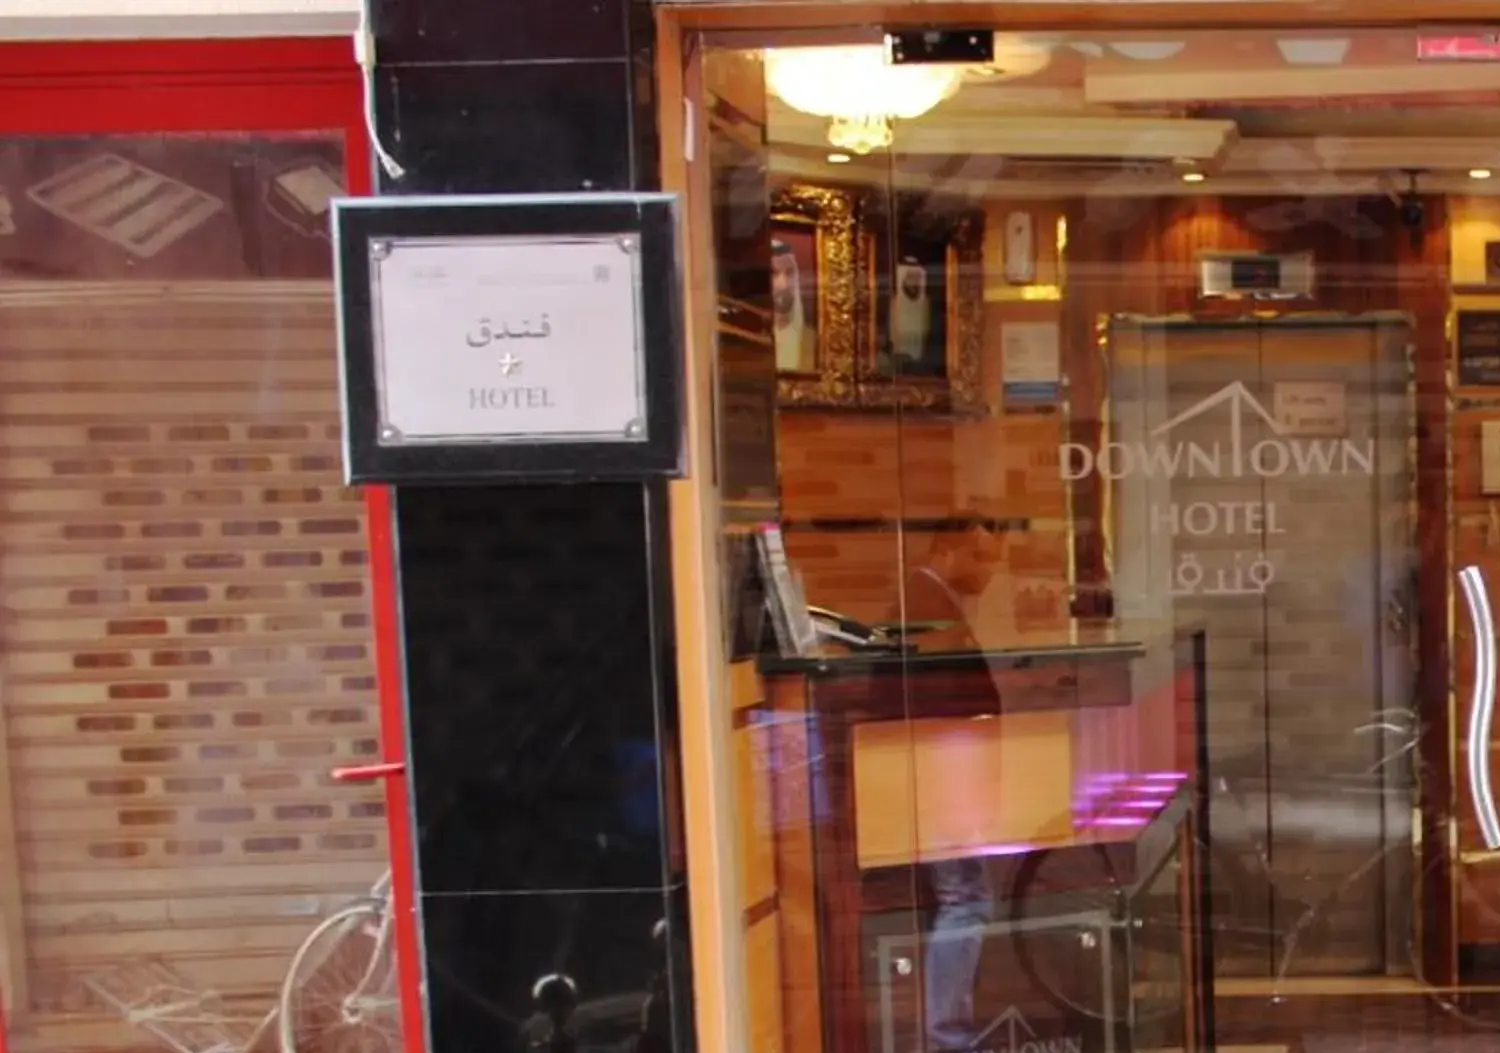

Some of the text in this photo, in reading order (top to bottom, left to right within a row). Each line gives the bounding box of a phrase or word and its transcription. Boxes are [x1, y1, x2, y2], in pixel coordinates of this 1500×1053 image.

[466, 312, 552, 348] فندق
[468, 387, 555, 410] HOTEL
[1150, 501, 1287, 535] HOTEL
[1167, 551, 1275, 595] فندق
